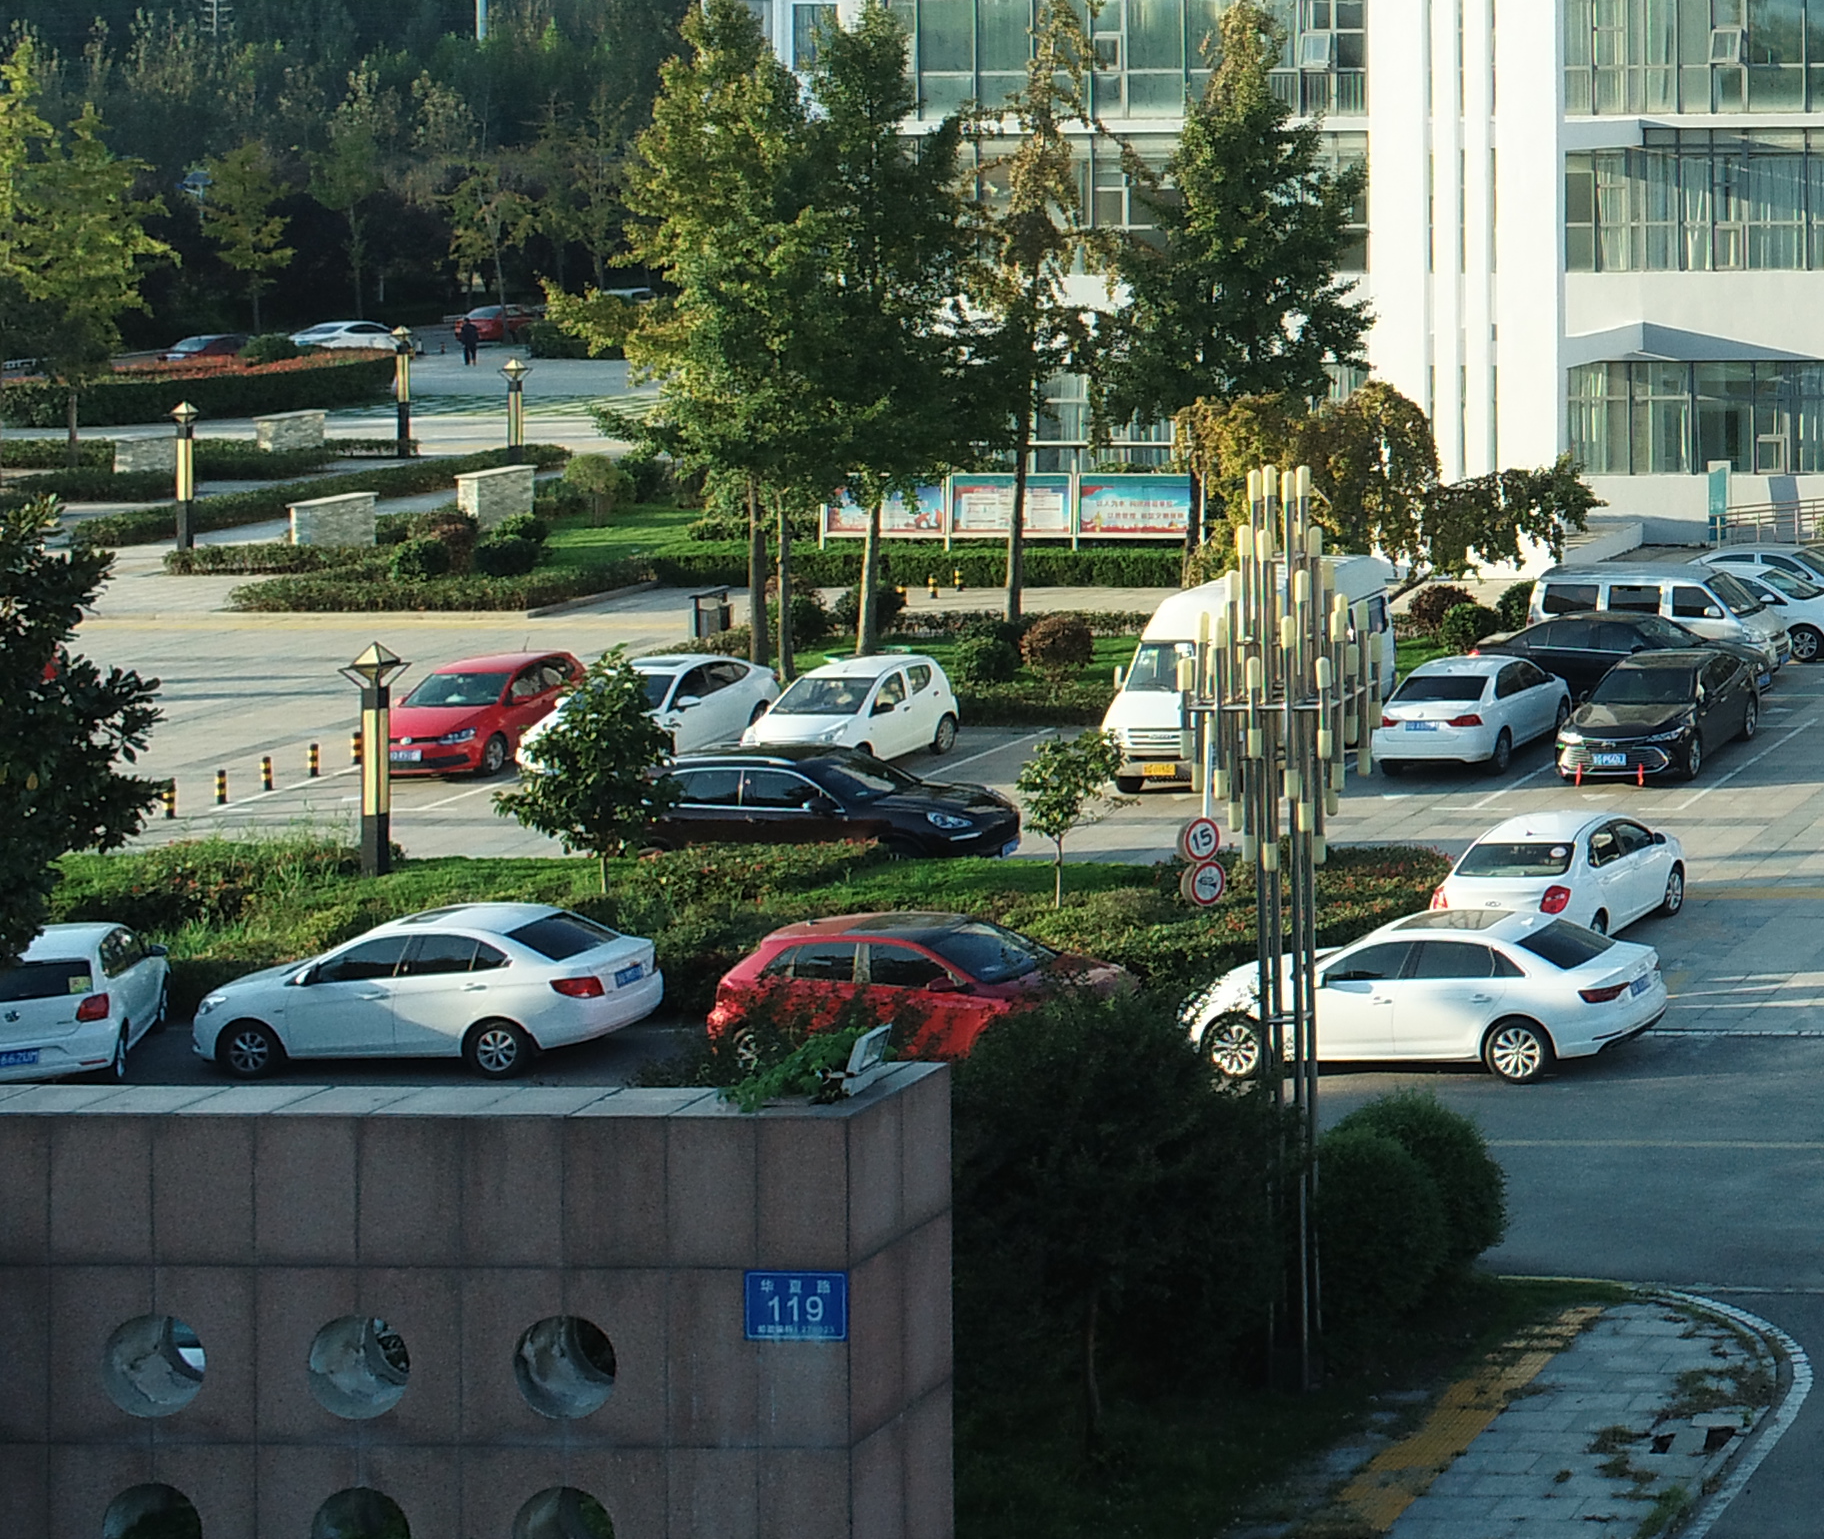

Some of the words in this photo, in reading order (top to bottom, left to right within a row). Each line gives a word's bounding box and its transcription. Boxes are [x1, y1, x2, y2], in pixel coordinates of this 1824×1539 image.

[1192, 827, 1213, 851] 15
[760, 1279, 831, 1294] 华夏路
[767, 1295, 824, 1323] 119
